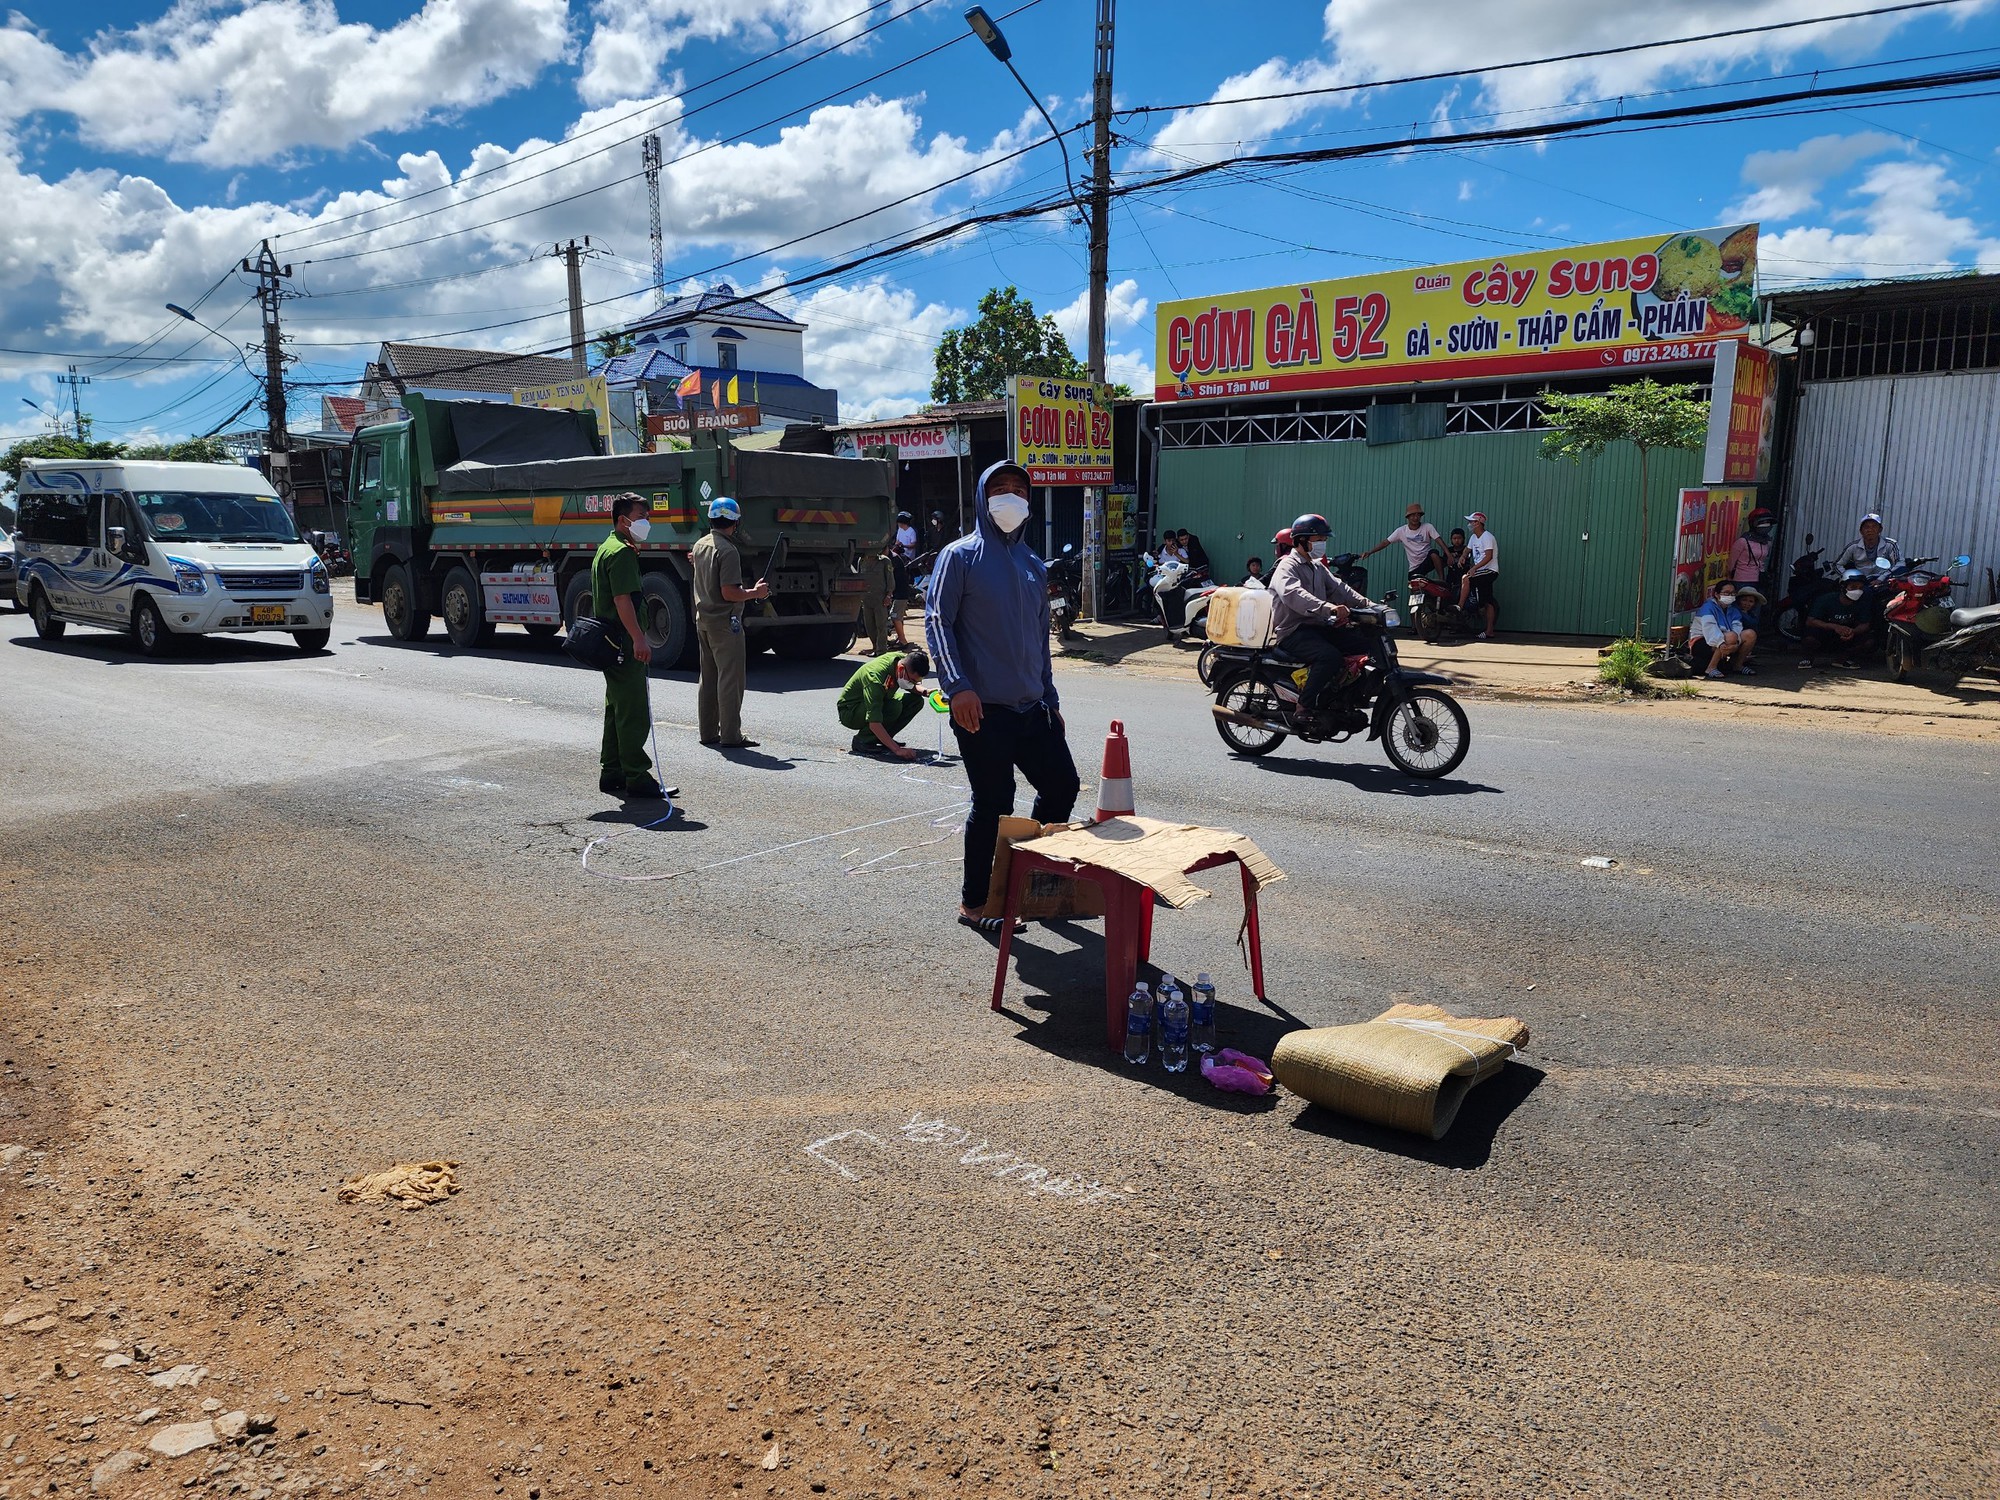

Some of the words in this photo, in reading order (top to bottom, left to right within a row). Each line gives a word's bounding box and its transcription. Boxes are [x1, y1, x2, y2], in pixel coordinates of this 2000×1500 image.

[1414, 275, 1451, 290] Quán
[1168, 306, 1255, 375] CƠM
[1265, 288, 1320, 367] GÀ
[1332, 292, 1389, 360] 52
[1406, 323, 1430, 357] GÀ
[1447, 315, 1499, 354] SƯỜN
[1518, 310, 1568, 352] THẬP
[1573, 298, 1623, 342] CẨM
[1642, 290, 1706, 336] PHẦN
[1623, 341, 1718, 363] 0973.248.777
[1199, 384, 1223, 397] Ship
[1227, 381, 1247, 395] Tận
[1250, 379, 1270, 392] Nơi
[1019, 403, 1060, 447] CƠM
[1064, 403, 1088, 447] GÀ
[1090, 410, 1111, 448] 52
